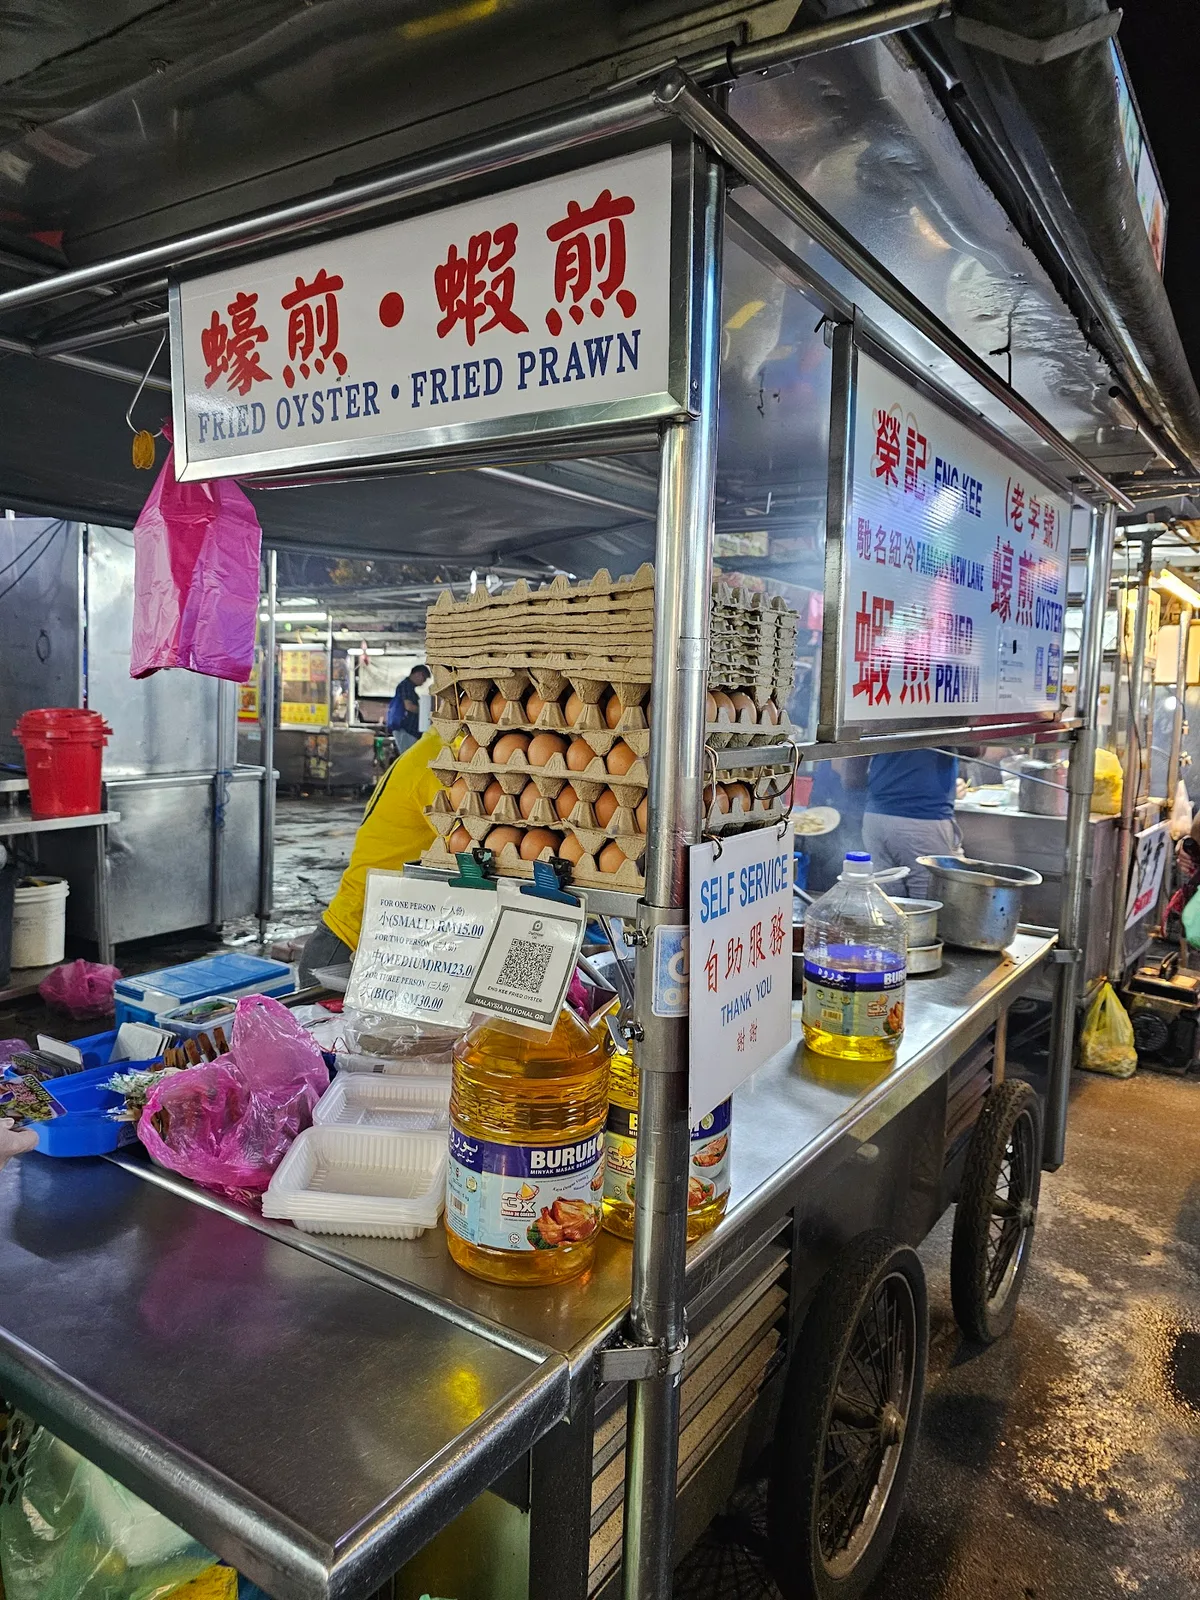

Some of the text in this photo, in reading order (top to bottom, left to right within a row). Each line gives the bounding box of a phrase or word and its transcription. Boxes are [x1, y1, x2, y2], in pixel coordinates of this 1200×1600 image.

[201, 189, 637, 396] 蠔煎 蝦煎
[199, 329, 641, 443] FRIED OYSTER FRIED PRAWN
[961, 472, 983, 518] KEE
[950, 553, 967, 587] NEW
[967, 559, 985, 592] LANE
[1035, 596, 1063, 633] OYSTER
[935, 664, 979, 703] PRAWN
[380, 899, 394, 907] FOR
[394, 900, 409, 909] ONE
[409, 902, 436, 912] PERSON
[700, 854, 788, 924] SELF SERVICE
[704, 907, 787, 993] 自助服務
[475, 998, 504, 1010] MALAYSIA
[504, 1003, 533, 1018] NATIONAL
[720, 975, 773, 1026] THANK YOU
[530, 1137, 597, 1169] BURUH
